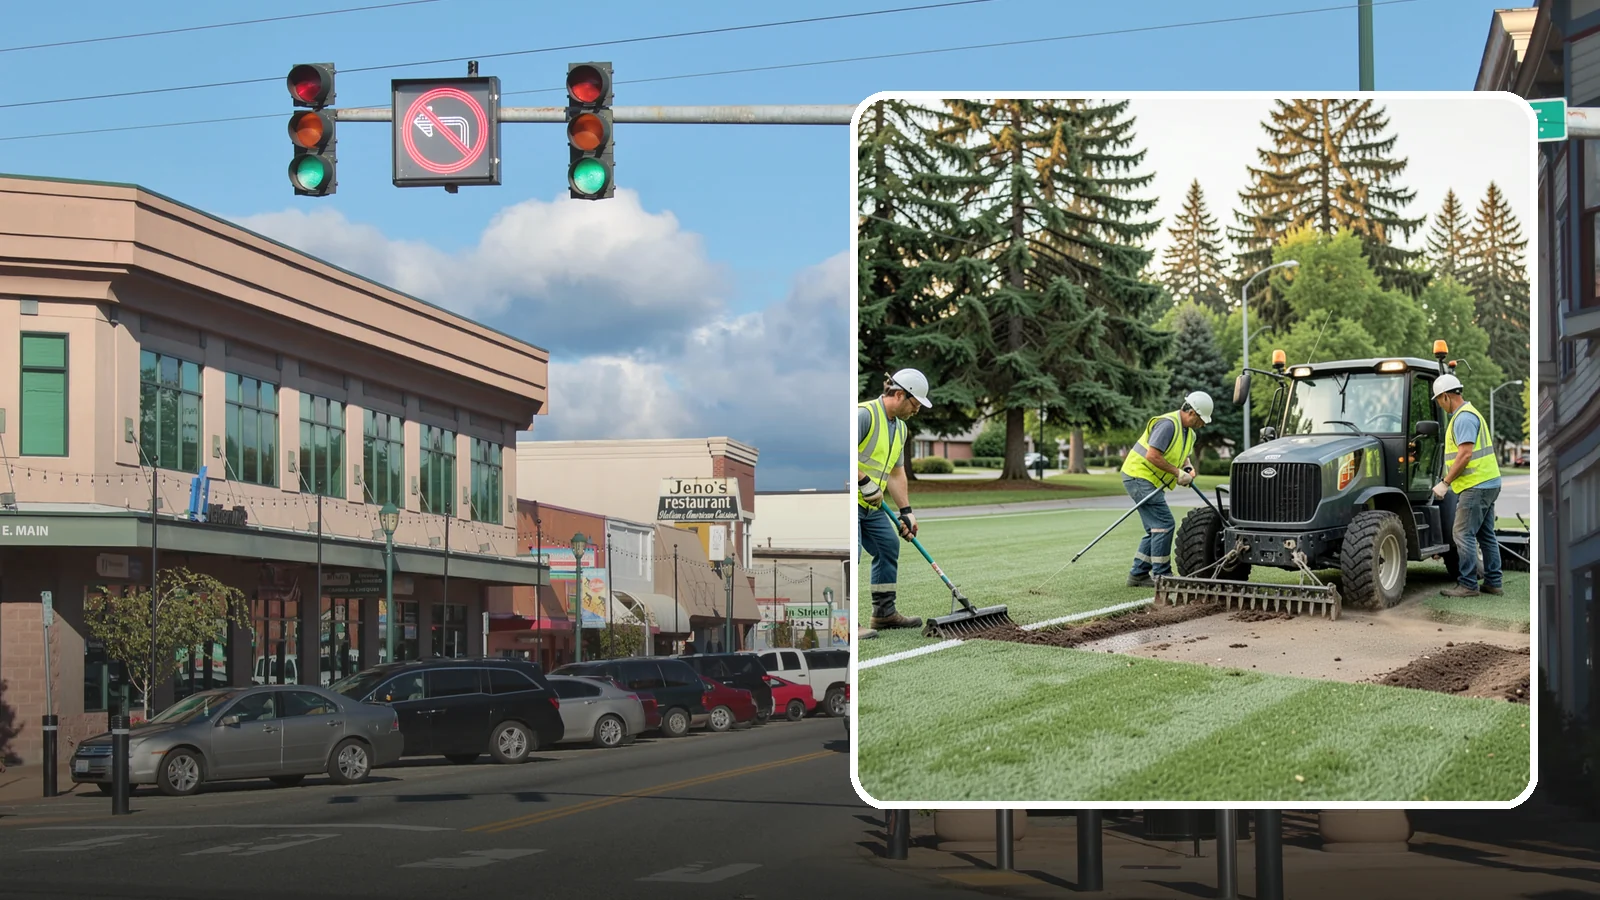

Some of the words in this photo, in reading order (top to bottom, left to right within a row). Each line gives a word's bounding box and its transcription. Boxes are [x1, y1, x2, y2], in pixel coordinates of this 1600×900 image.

[670, 480, 727, 494] Jeno's
[665, 497, 731, 509] restaurant
[659, 510, 681, 519] Italian
[686, 510, 714, 519] American
[715, 510, 737, 519] Cuisine
[2, 525, 13, 536] E.
[15, 525, 49, 536] MAIN
[797, 607, 828, 617] Street
